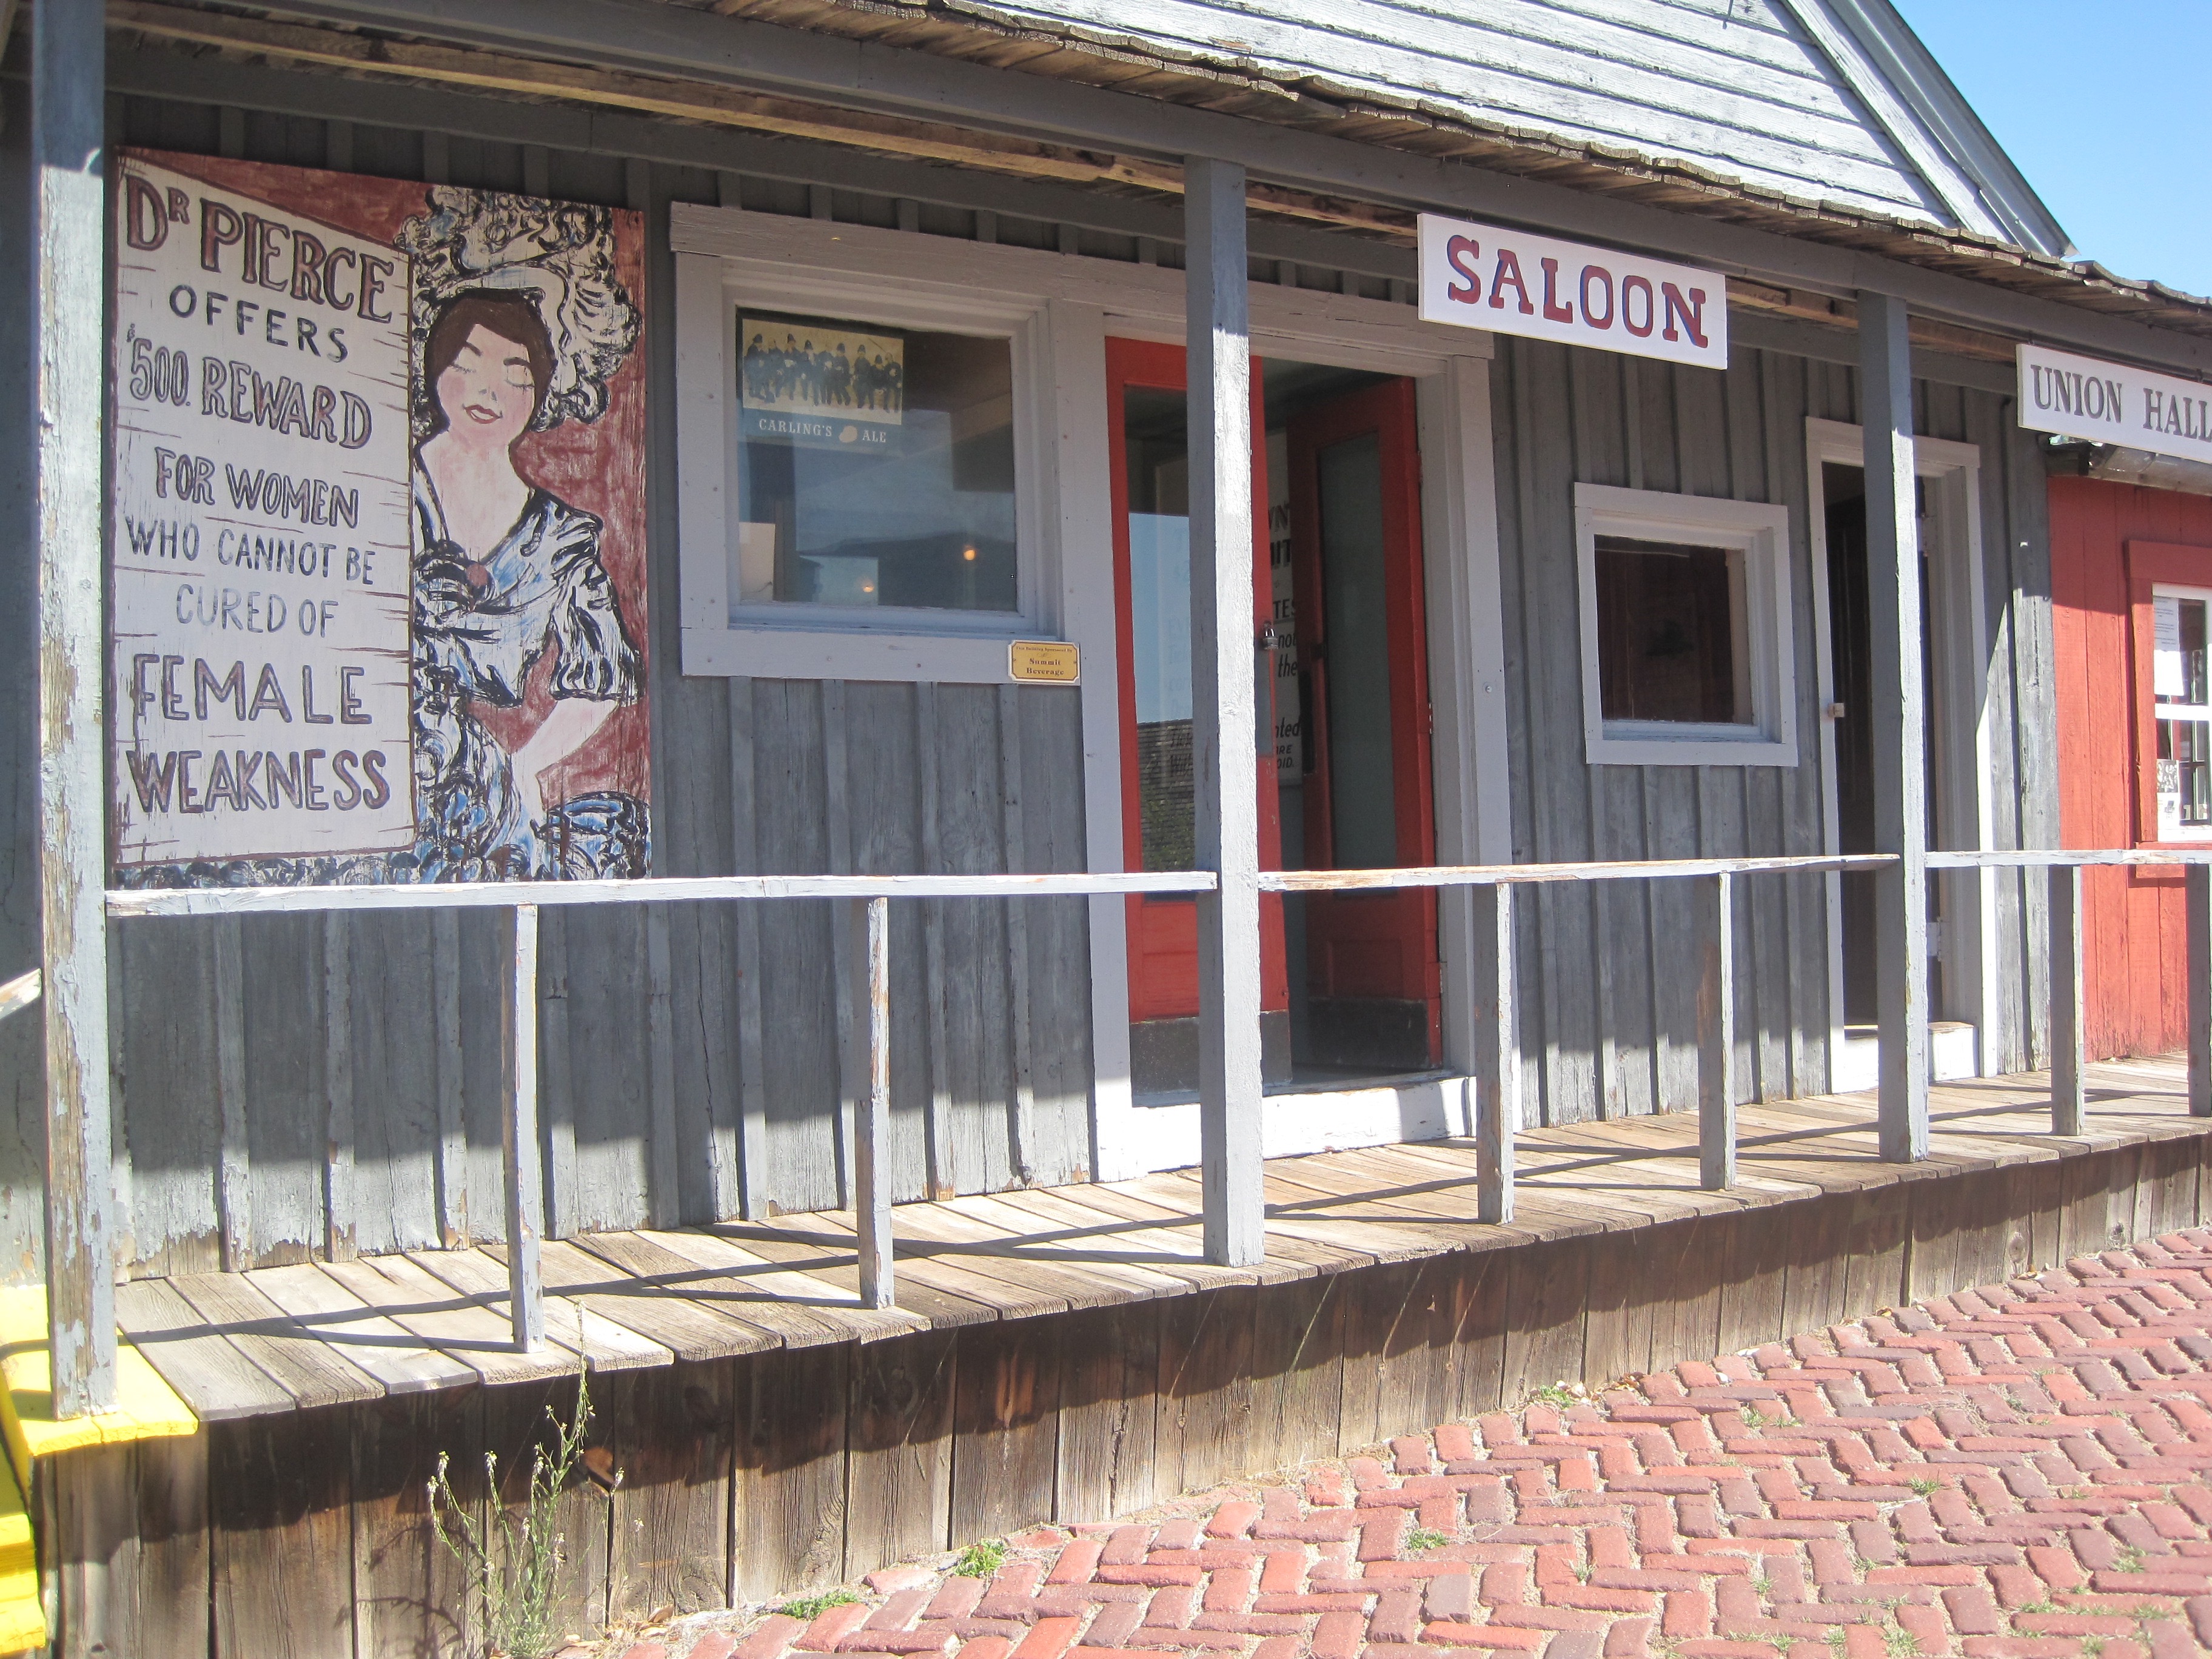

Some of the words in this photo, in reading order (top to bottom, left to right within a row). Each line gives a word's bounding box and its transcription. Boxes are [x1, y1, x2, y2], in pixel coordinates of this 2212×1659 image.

[200, 198, 394, 324] PIERCE
[1447, 235, 1709, 349] SALOON
[169, 284, 348, 363] OFFERS
[201, 357, 372, 449] REWARD
[759, 418, 833, 437] CARLING'S
[862, 429, 886, 443] ALE
[2030, 364, 2122, 423] UNION
[2142, 387, 2212, 443] HALL
[154, 446, 216, 506] FOR
[225, 463, 359, 529] WOMEN
[125, 515, 200, 561] WHO
[218, 529, 337, 578] CANNOT
[346, 546, 376, 585] BE
[176, 584, 287, 633] CURED
[298, 598, 339, 638] OF
[133, 653, 372, 725] FEMALE
[1026, 667, 1064, 676] Beverage
[1278, 654, 1298, 677] the
[126, 749, 391, 813] WEAKNESS
